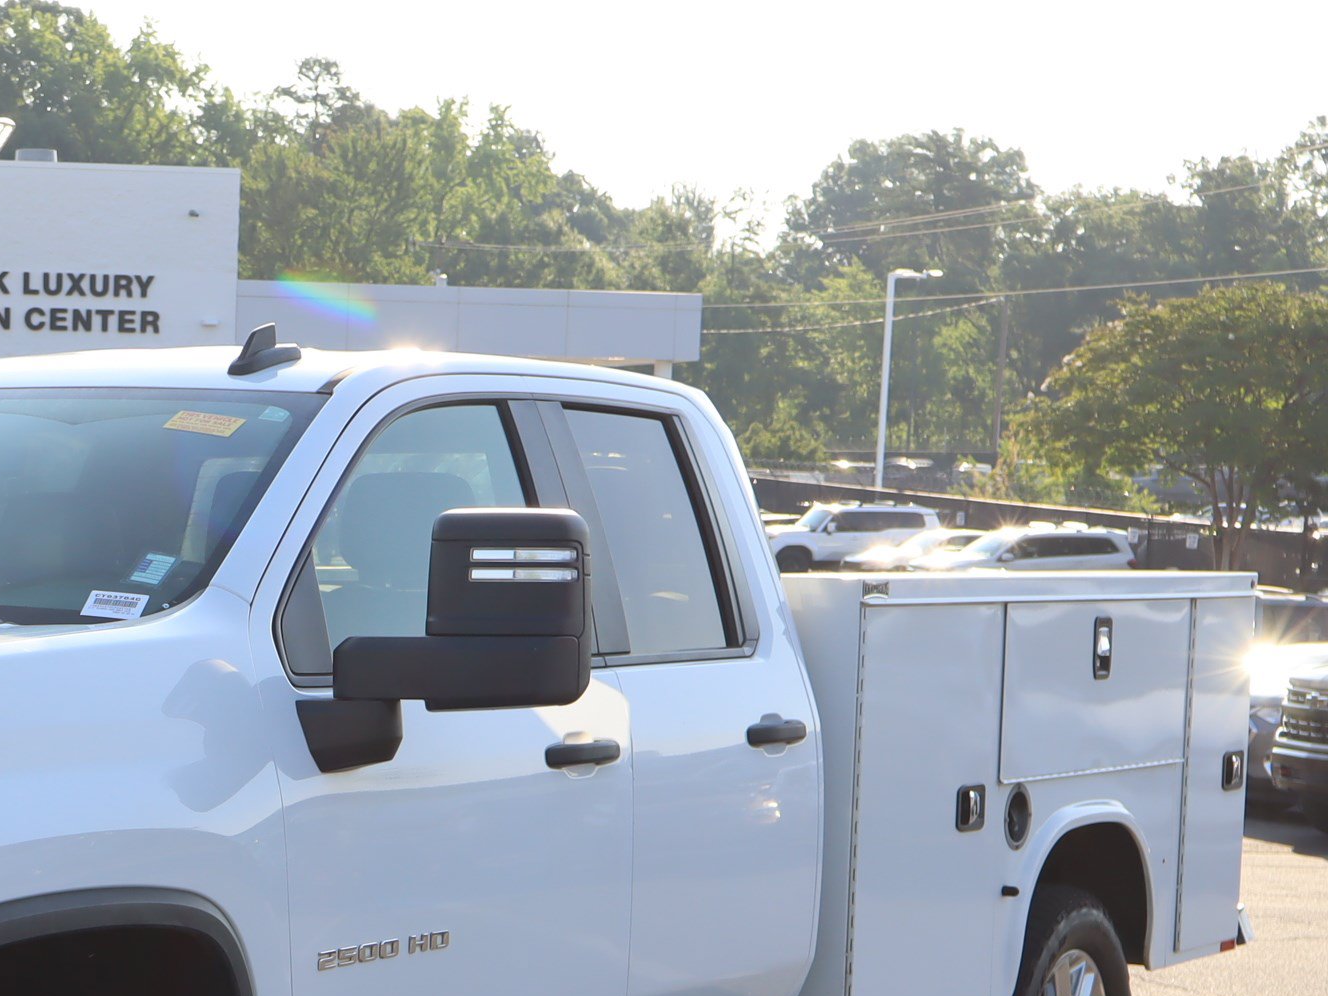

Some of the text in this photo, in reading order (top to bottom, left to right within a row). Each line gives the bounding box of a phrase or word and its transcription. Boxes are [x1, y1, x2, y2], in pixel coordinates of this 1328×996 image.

[23, 272, 155, 298] LUXURY
[24, 307, 160, 334] CENTER
[317, 930, 450, 971] 2500 HD
